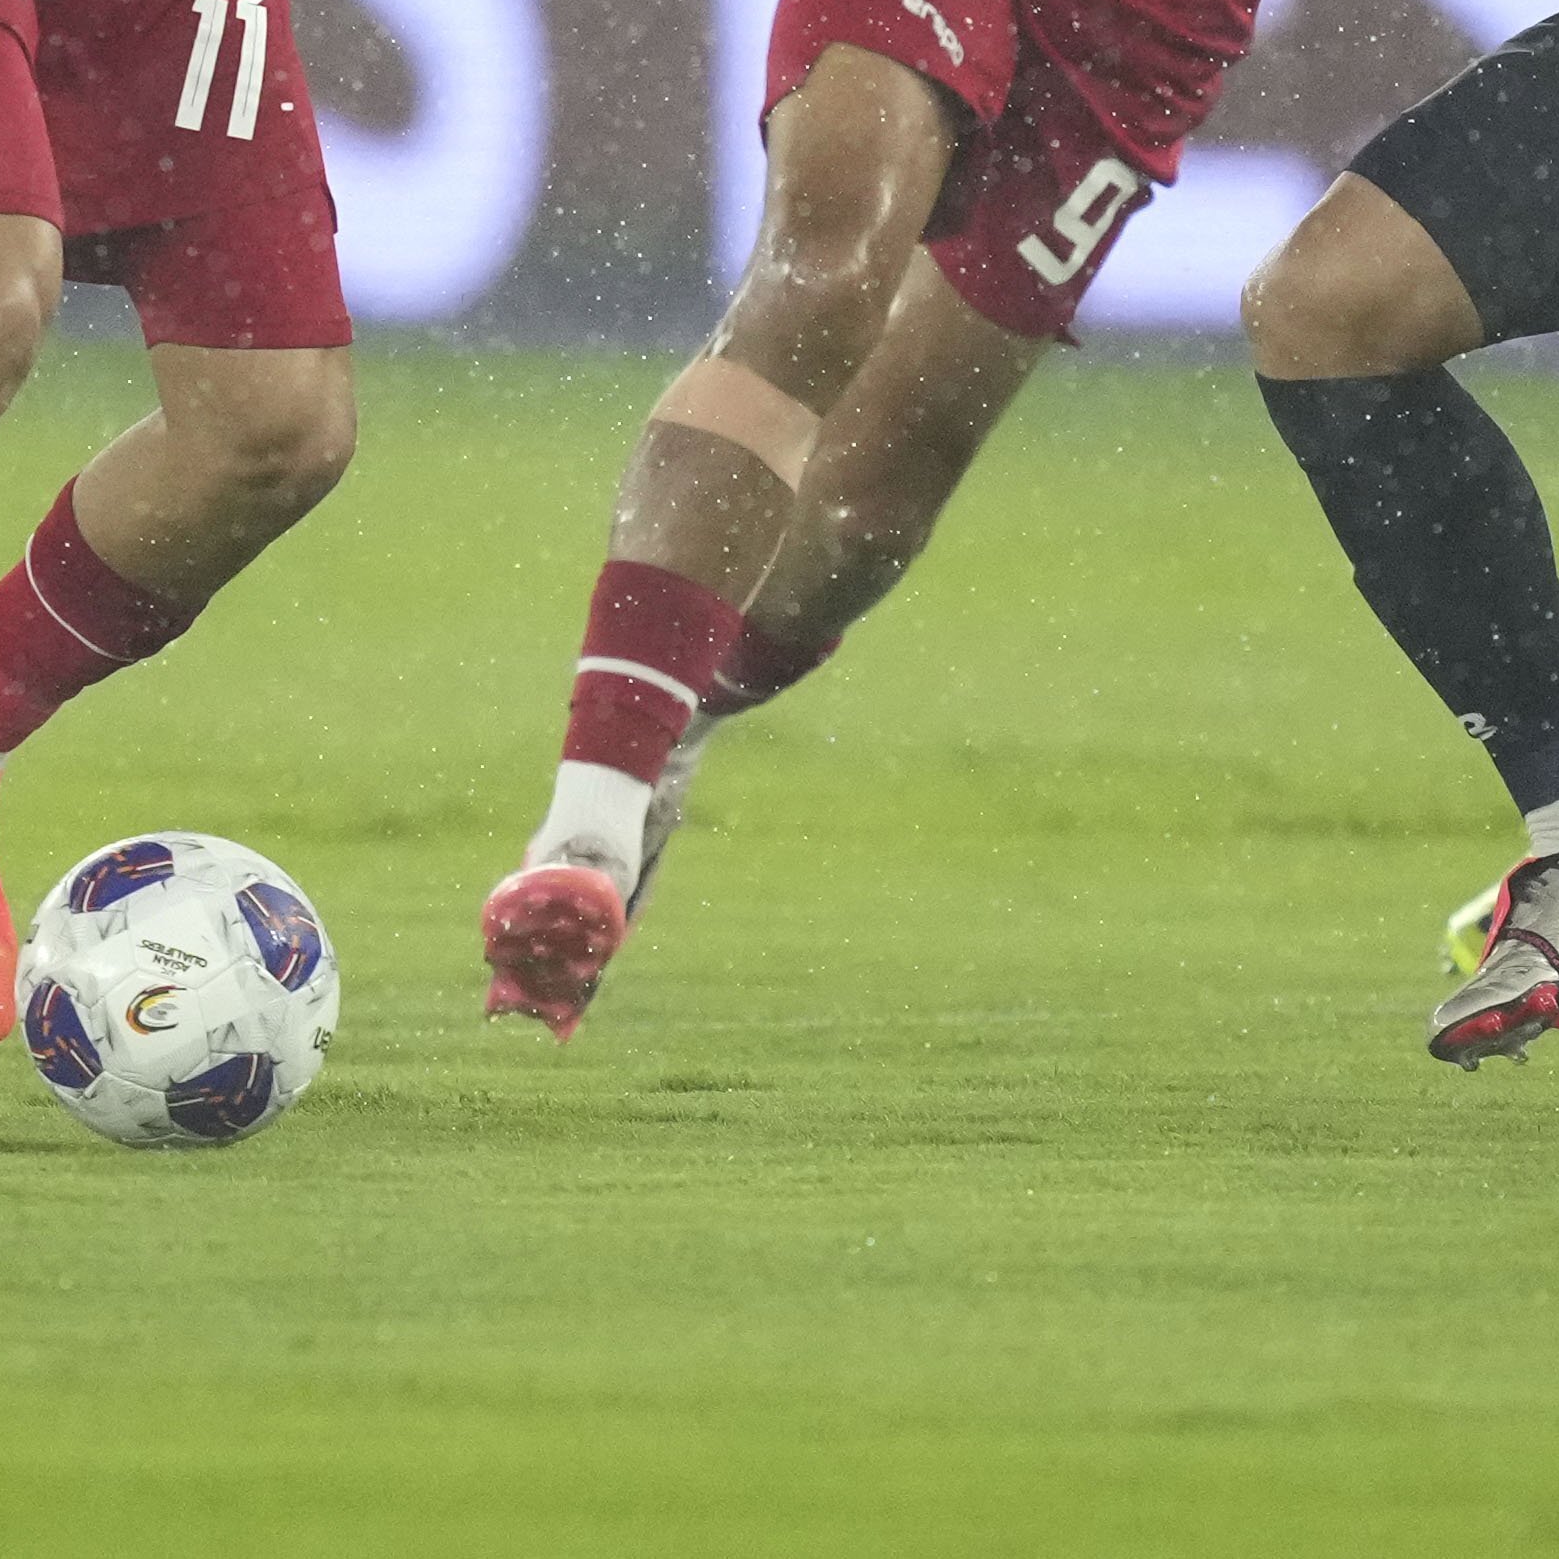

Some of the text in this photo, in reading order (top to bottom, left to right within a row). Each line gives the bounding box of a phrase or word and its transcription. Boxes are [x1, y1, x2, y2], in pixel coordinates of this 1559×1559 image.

[1017, 157, 1142, 287] 9
[138, 939, 208, 968] QUALIFIERS
[152, 954, 191, 972] ASIAN
